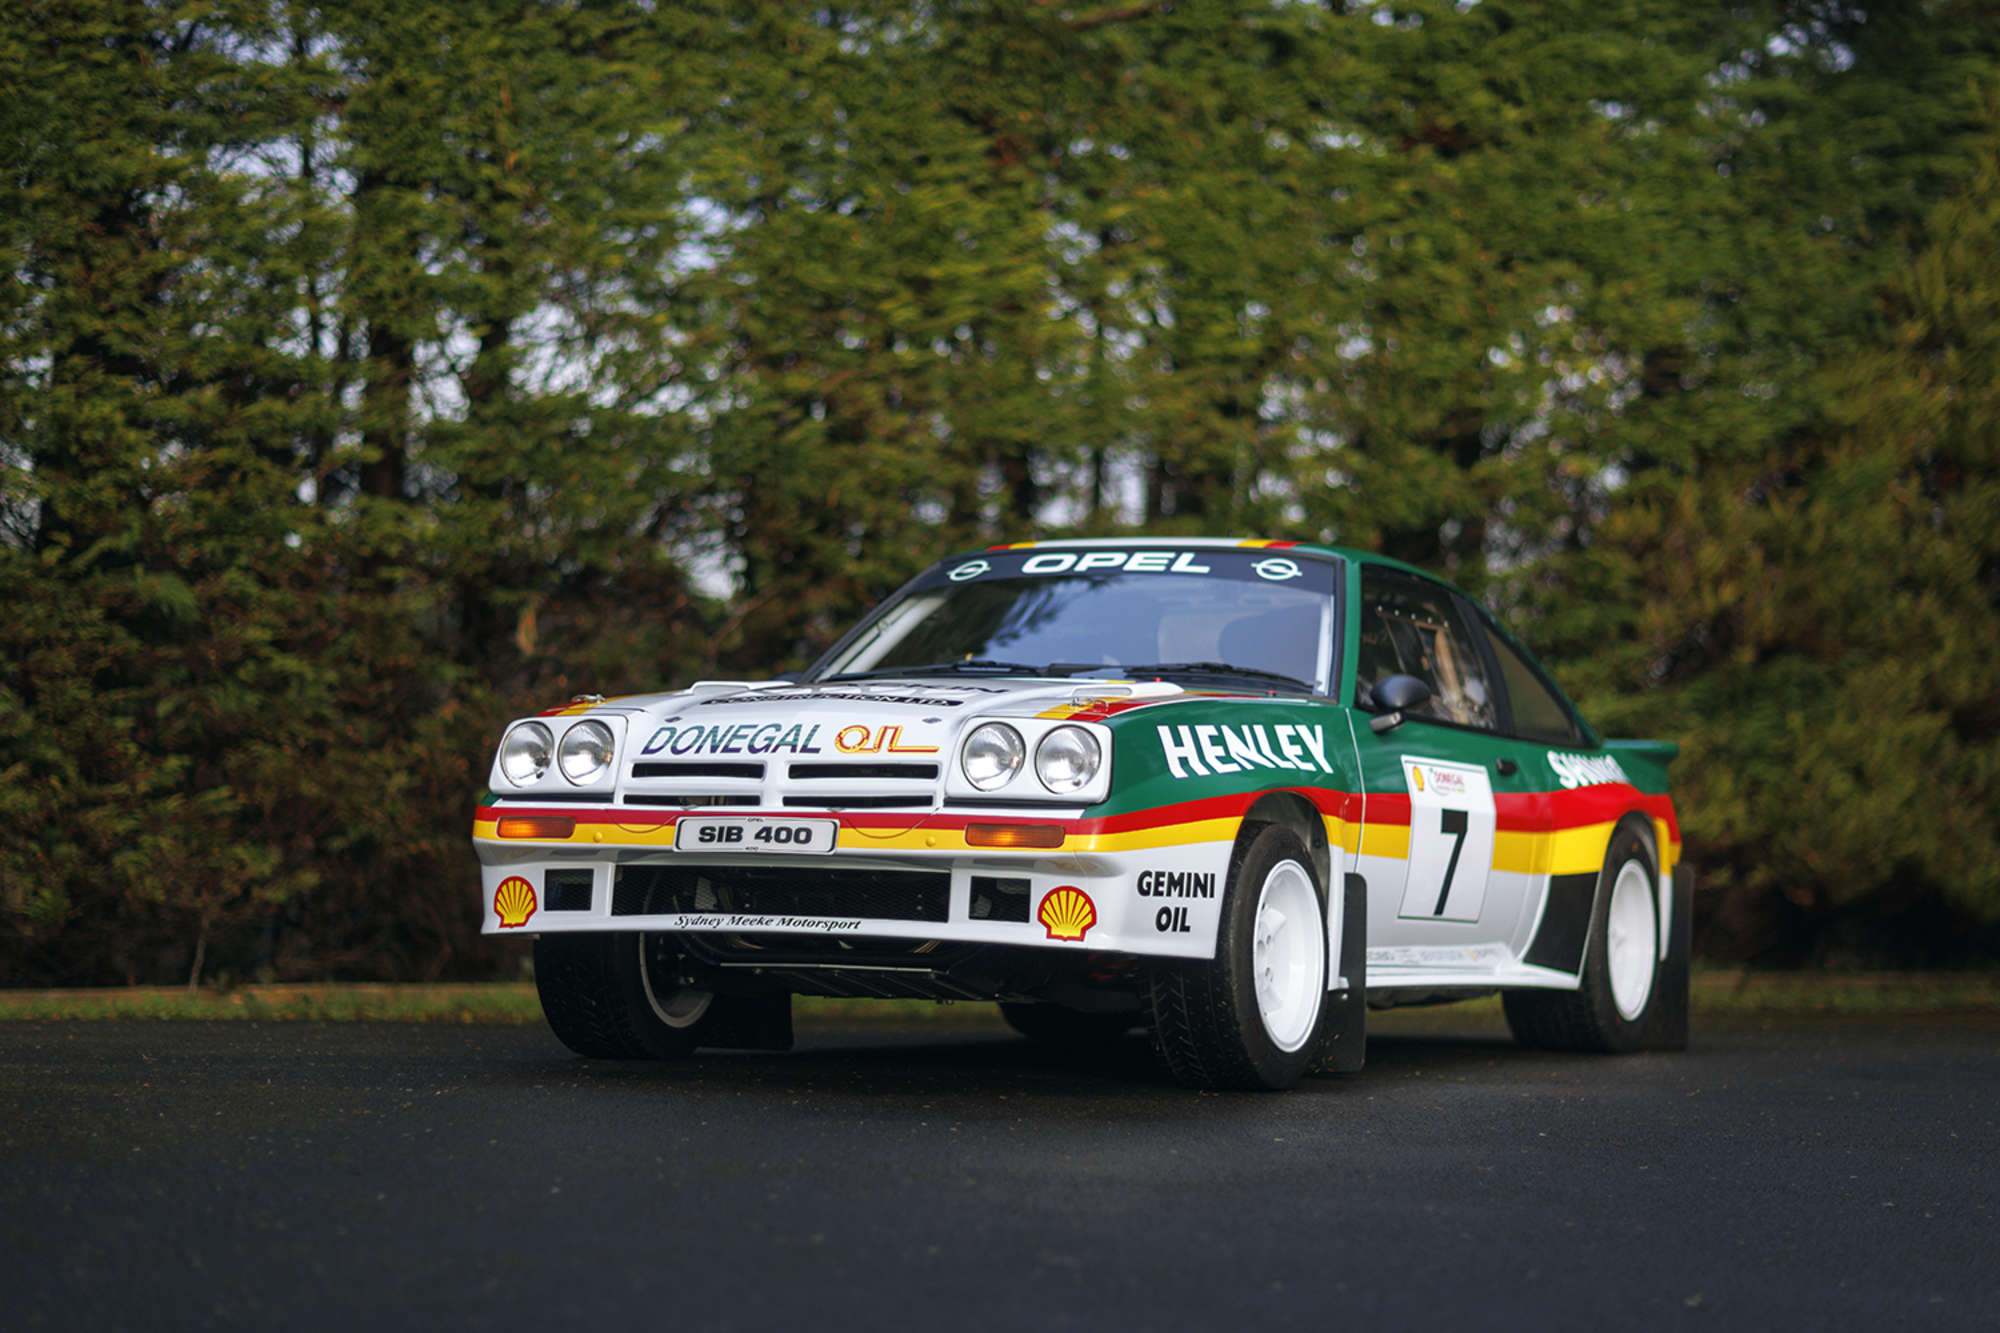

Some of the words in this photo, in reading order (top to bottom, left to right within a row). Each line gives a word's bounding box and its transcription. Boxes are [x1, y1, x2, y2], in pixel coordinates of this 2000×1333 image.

[1021, 552, 1211, 574] OPEL
[640, 723, 822, 756] DONEGAL
[834, 724, 941, 755] OIL
[1156, 724, 1334, 779] HENLEY
[698, 826, 744, 843] SIB
[754, 826, 813, 844] 400
[1433, 808, 1468, 916] 7
[1137, 870, 1216, 898] GEMINI
[674, 915, 724, 929] Sydney
[727, 916, 774, 926] Meeke
[776, 917, 862, 931] Motorsport
[1155, 906, 1191, 932] OIL
